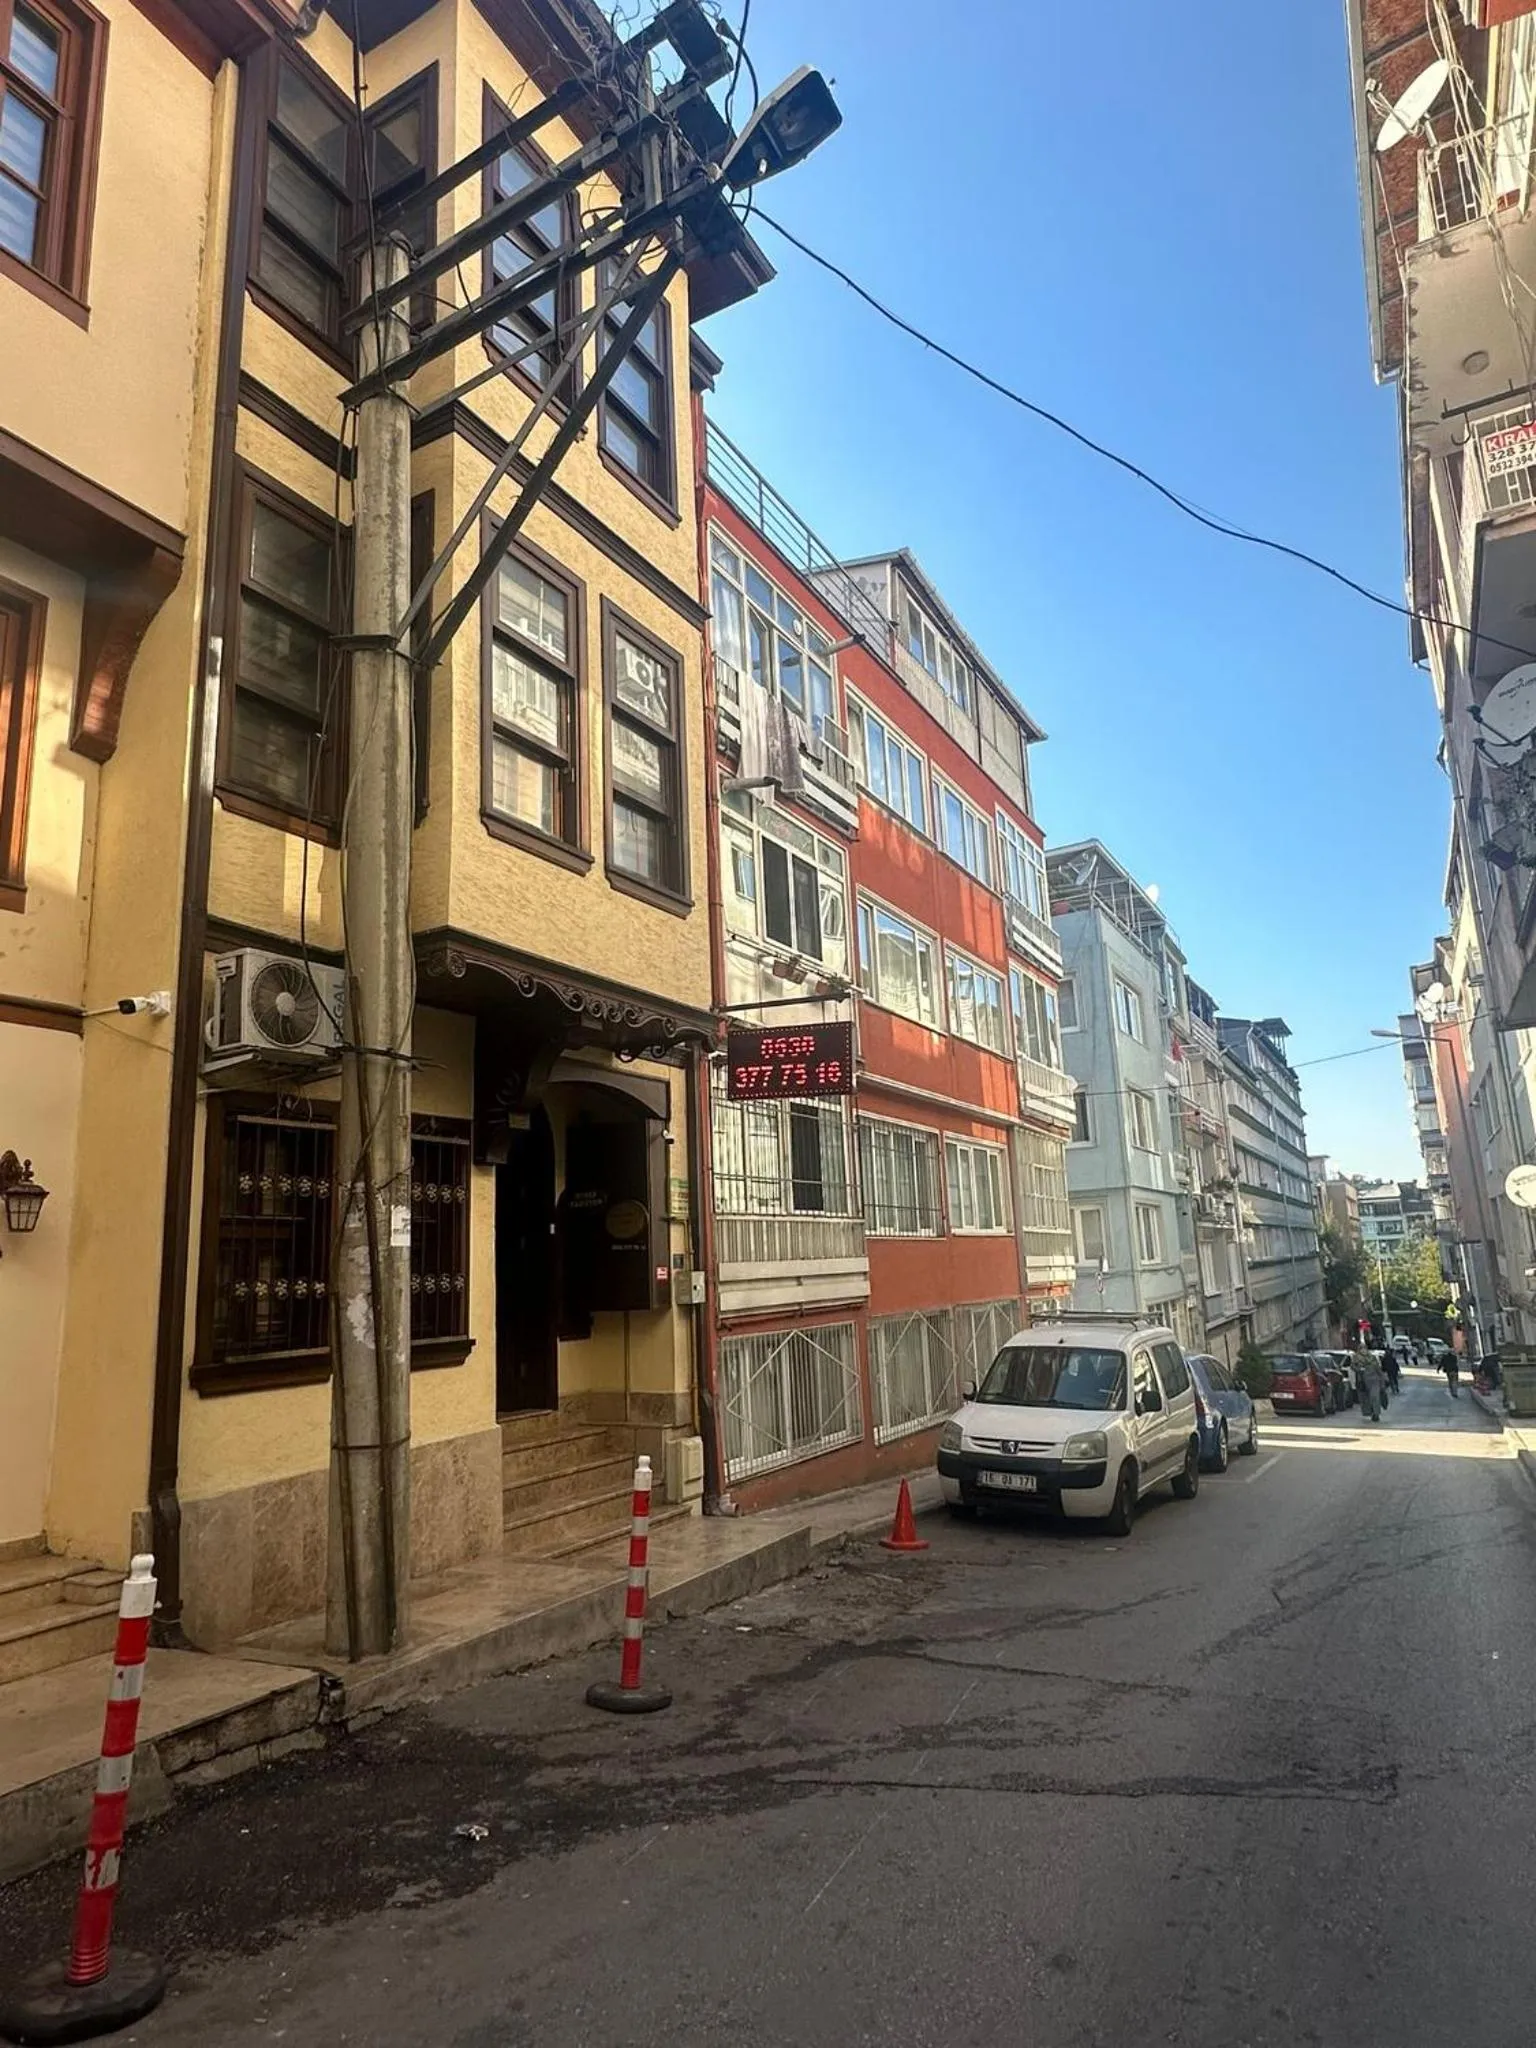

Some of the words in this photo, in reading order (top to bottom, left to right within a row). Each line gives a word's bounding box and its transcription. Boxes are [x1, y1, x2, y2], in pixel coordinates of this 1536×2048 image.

[1488, 447, 1516, 462] 328
[1490, 459, 1513, 474] 0532
[735, 1065, 774, 1088] 377
[781, 1063, 808, 1086] 75
[815, 1061, 842, 1084] 16
